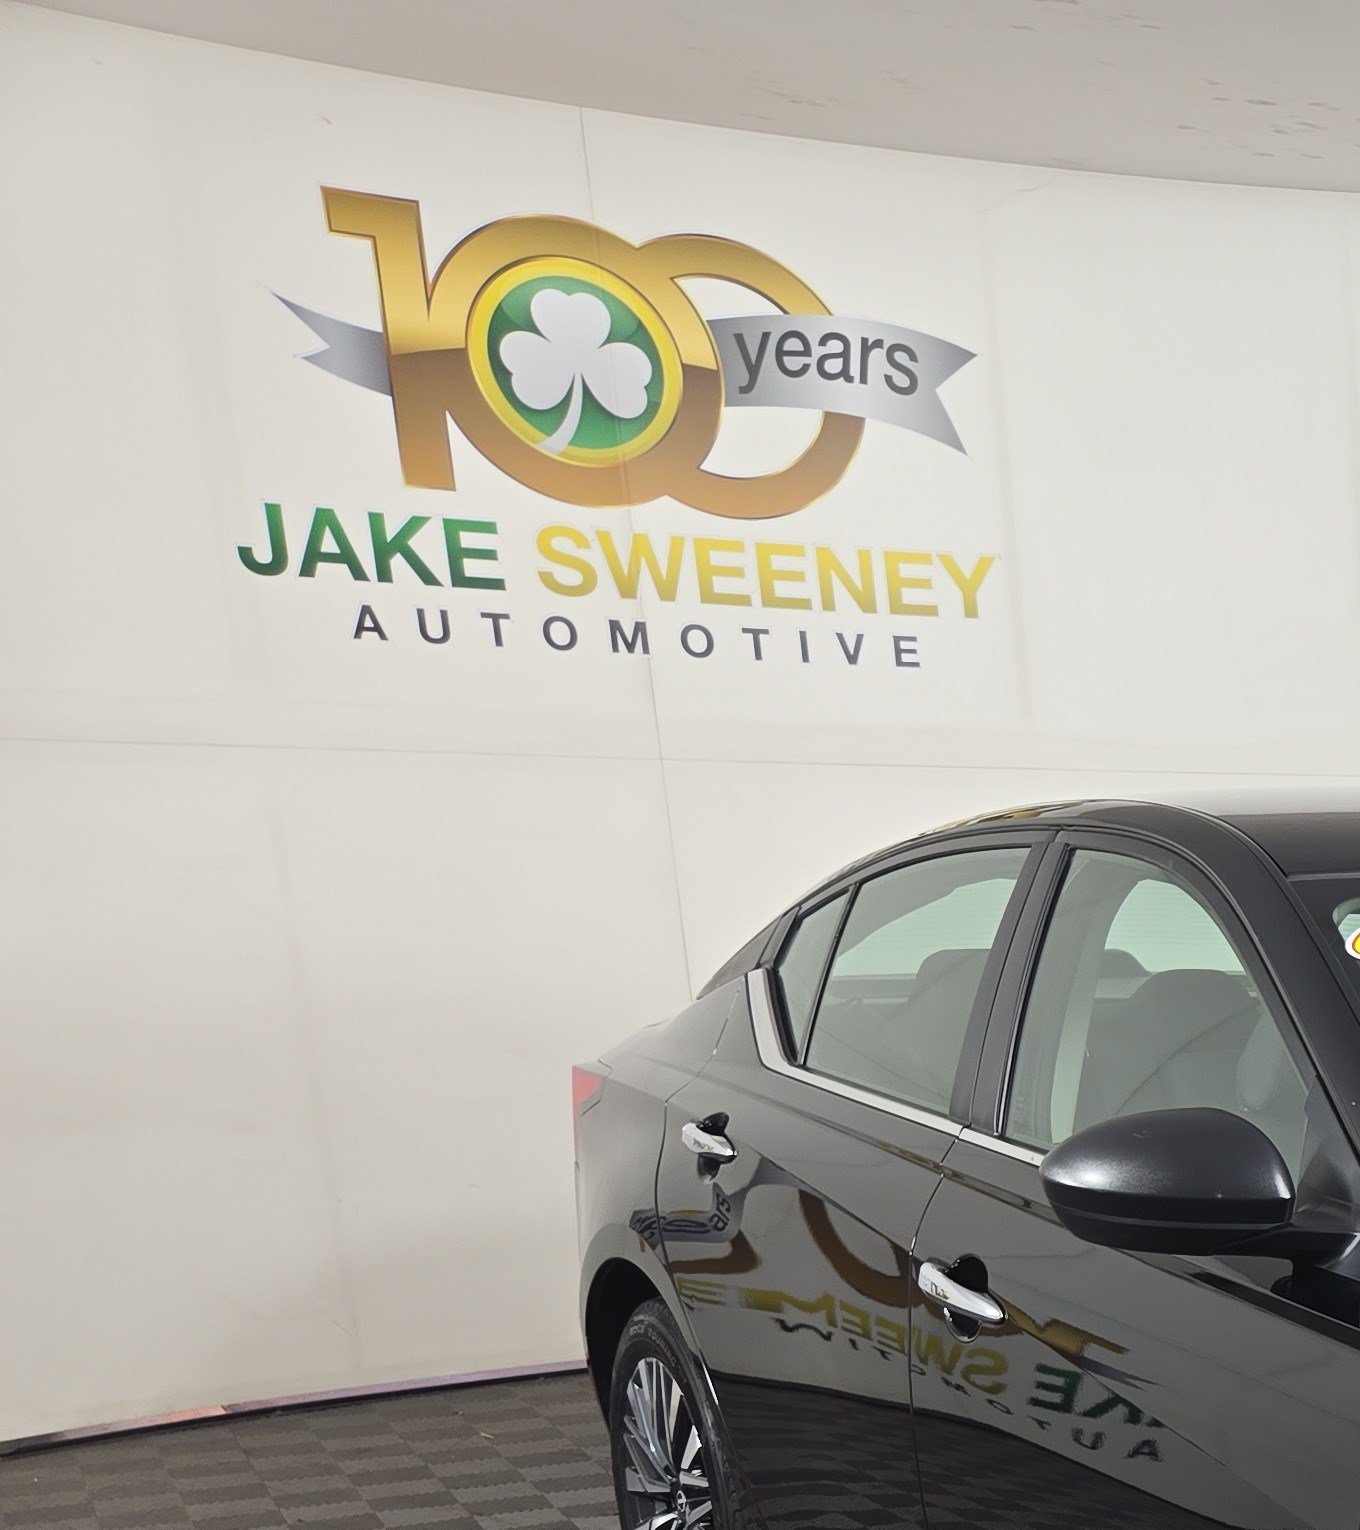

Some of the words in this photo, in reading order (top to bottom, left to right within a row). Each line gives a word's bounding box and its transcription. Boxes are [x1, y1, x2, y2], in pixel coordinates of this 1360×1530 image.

[733, 329, 920, 396] years
[236, 502, 507, 591] JAKE
[537, 525, 996, 619] SWEENEY
[353, 604, 921, 668] AUTOMOTIVE
